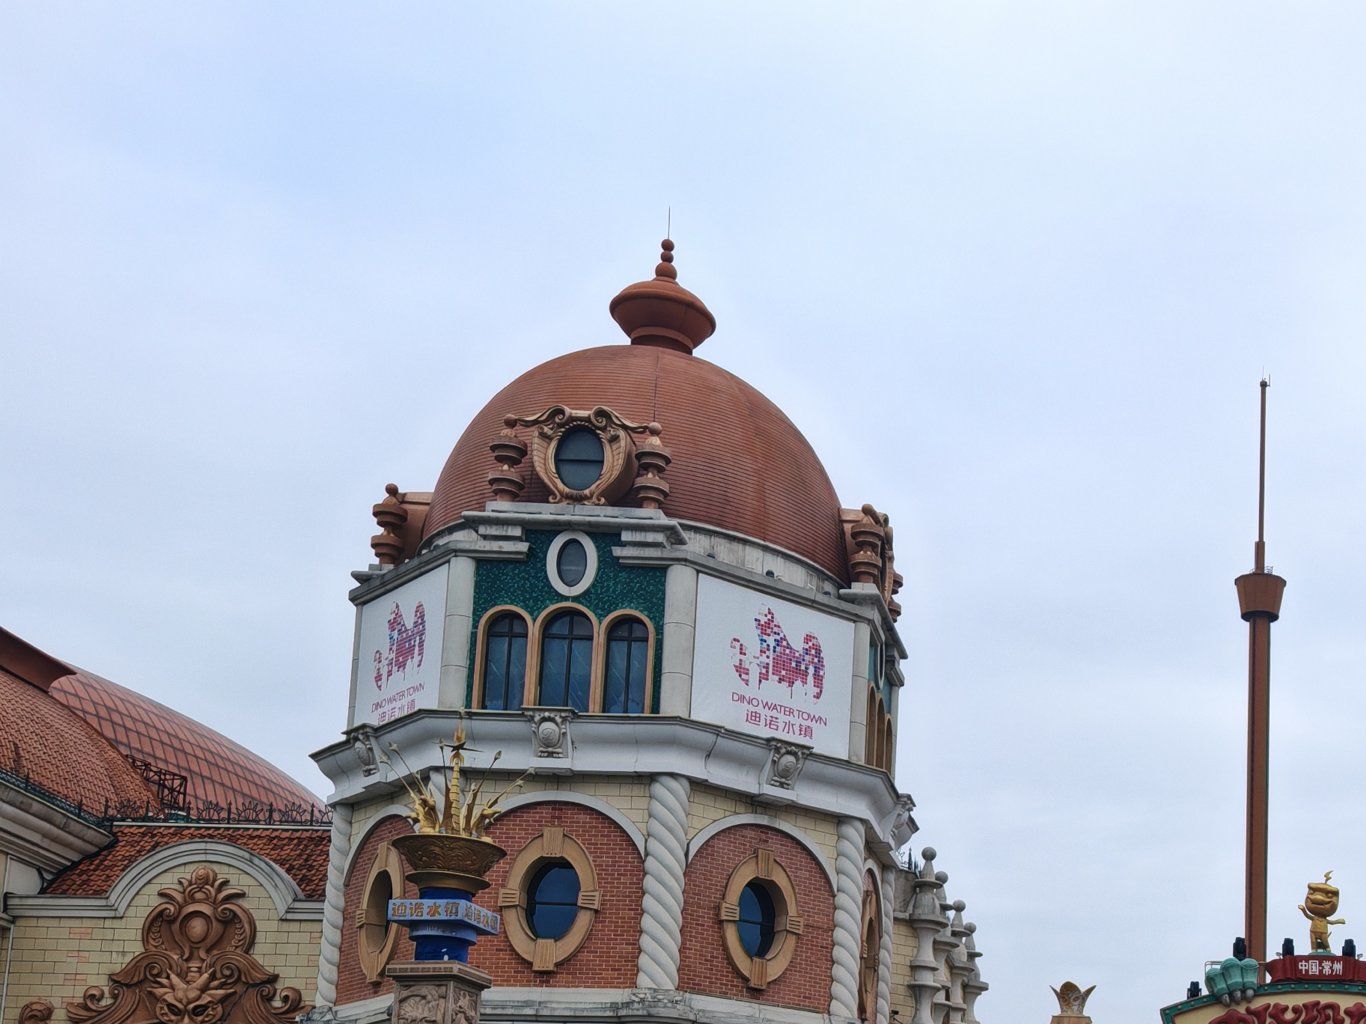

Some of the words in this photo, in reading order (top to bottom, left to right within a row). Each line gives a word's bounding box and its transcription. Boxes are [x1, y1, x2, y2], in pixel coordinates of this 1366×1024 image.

[731, 691, 760, 708] DINO
[761, 699, 796, 718] WATER
[796, 709, 828, 727] TOWN
[745, 708, 814, 740] 迪诺水镇
